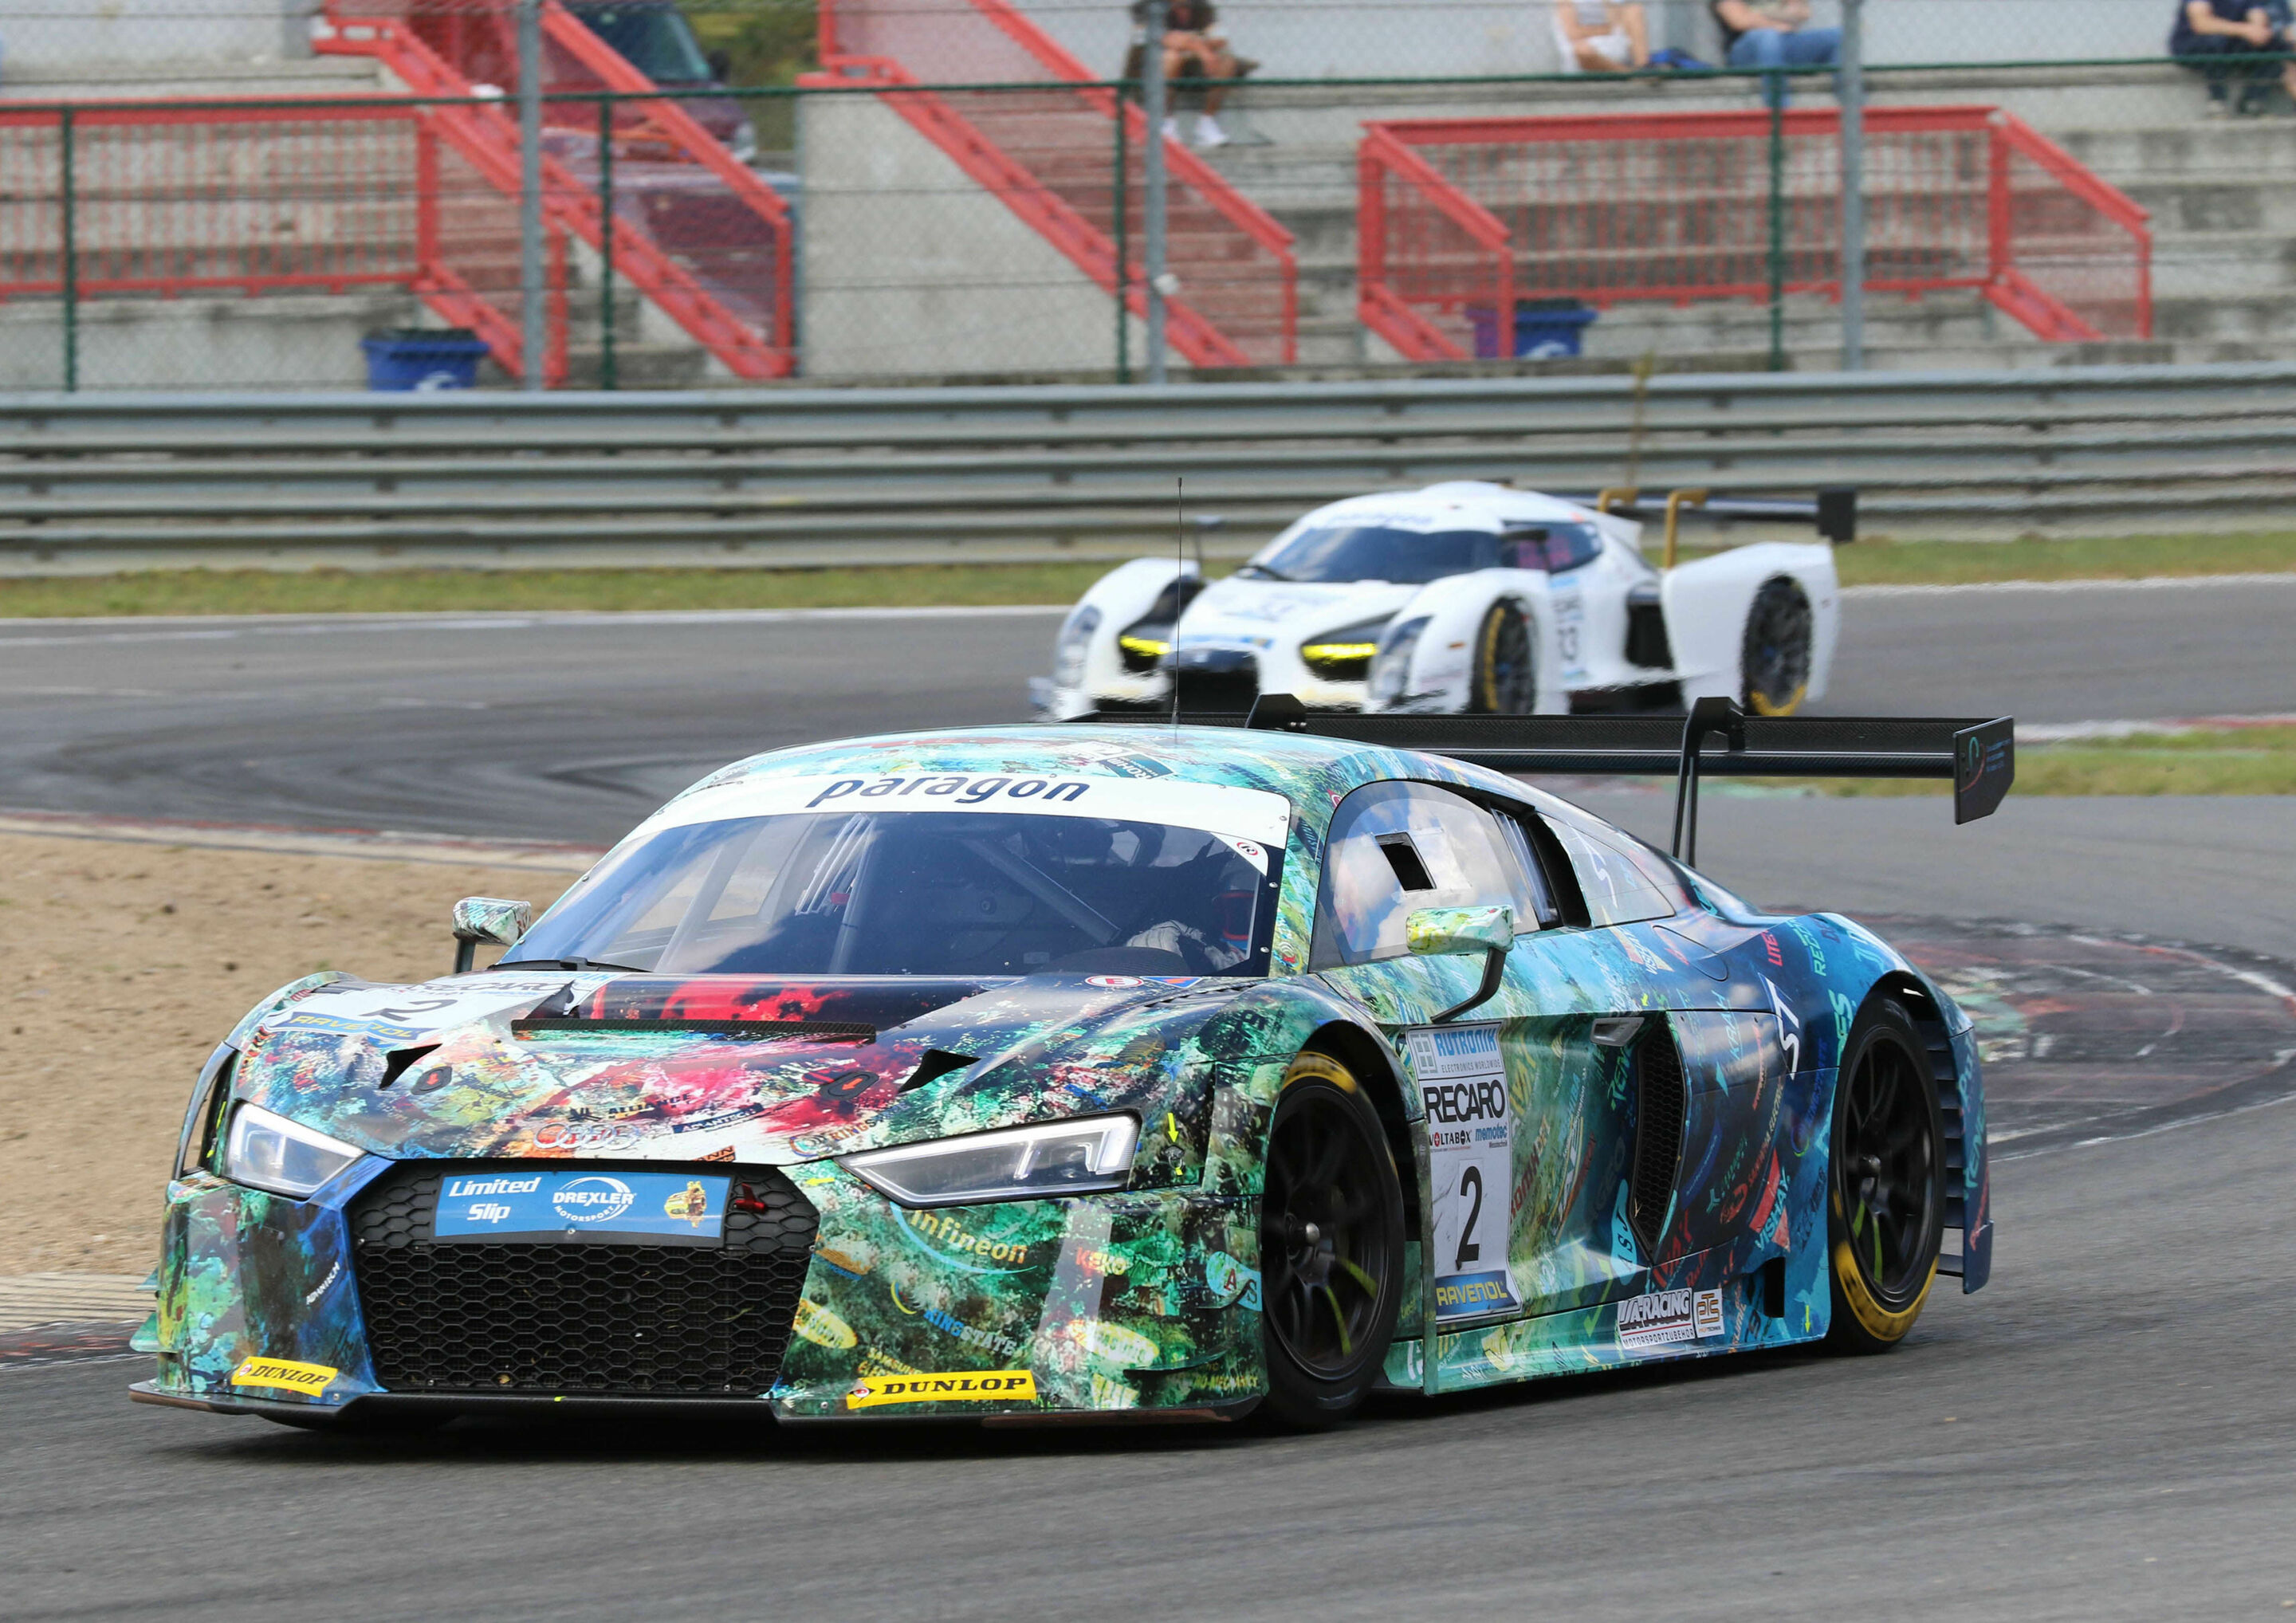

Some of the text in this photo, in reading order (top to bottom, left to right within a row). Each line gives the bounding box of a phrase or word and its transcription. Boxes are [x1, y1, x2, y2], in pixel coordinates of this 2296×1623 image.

[805, 775, 1091, 808] paragon
[1433, 1028, 1497, 1056] RUTRONIK
[1441, 1062, 1474, 1073] ELECTRONICS
[1423, 1079, 1506, 1124] RECARO
[1429, 1130, 1471, 1147] VOLTABOX
[1475, 1124, 1508, 1142] memotec
[448, 1177, 542, 1197] Limited
[552, 1192, 635, 1207] DREXLER
[467, 1203, 512, 1224] Slip
[553, 1205, 615, 1223] MOTORSPORT
[1457, 1166, 1483, 1261] 2
[1436, 1281, 1508, 1307] RAVENOL
[923, 1308, 1017, 1356] KINGSTATE
[250, 1365, 329, 1385] DUNLOP
[882, 1377, 1028, 1395] DUNLOP
